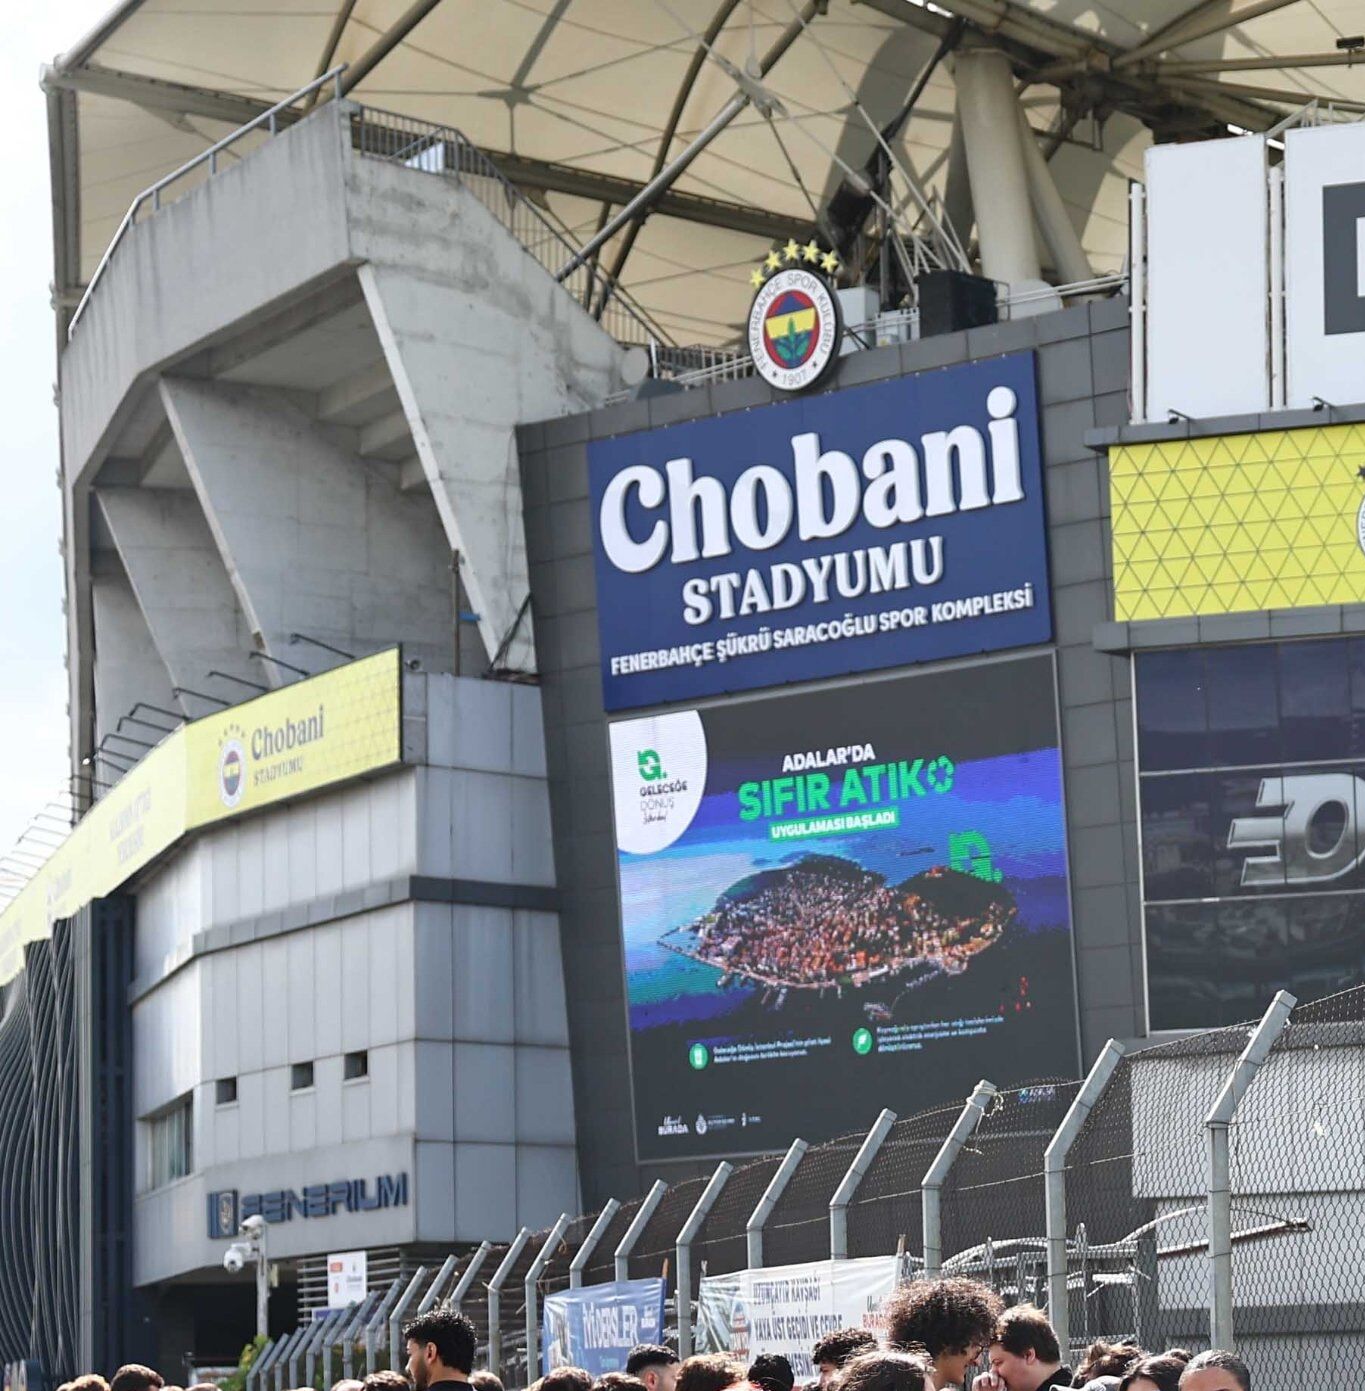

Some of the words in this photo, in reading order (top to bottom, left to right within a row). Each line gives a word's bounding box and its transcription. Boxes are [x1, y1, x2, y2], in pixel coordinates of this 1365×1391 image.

[600, 386, 1025, 573] Chobani
[682, 536, 945, 626] STADYUMU
[611, 642, 715, 676] FENERBAHÇE
[716, 628, 771, 664] ŞÜKRÜ
[773, 612, 877, 650] SARACOĞLU
[879, 608, 928, 632] SPOR
[931, 583, 1033, 624] KOMPLEKSİ
[251, 704, 324, 760] Chobani
[782, 743, 876, 772] ADALAR'DA
[738, 772, 831, 822] SIFIR
[839, 757, 927, 807] ATIK
[771, 818, 845, 839] UYGULAMASI
[846, 811, 896, 830] BAŞLADI
